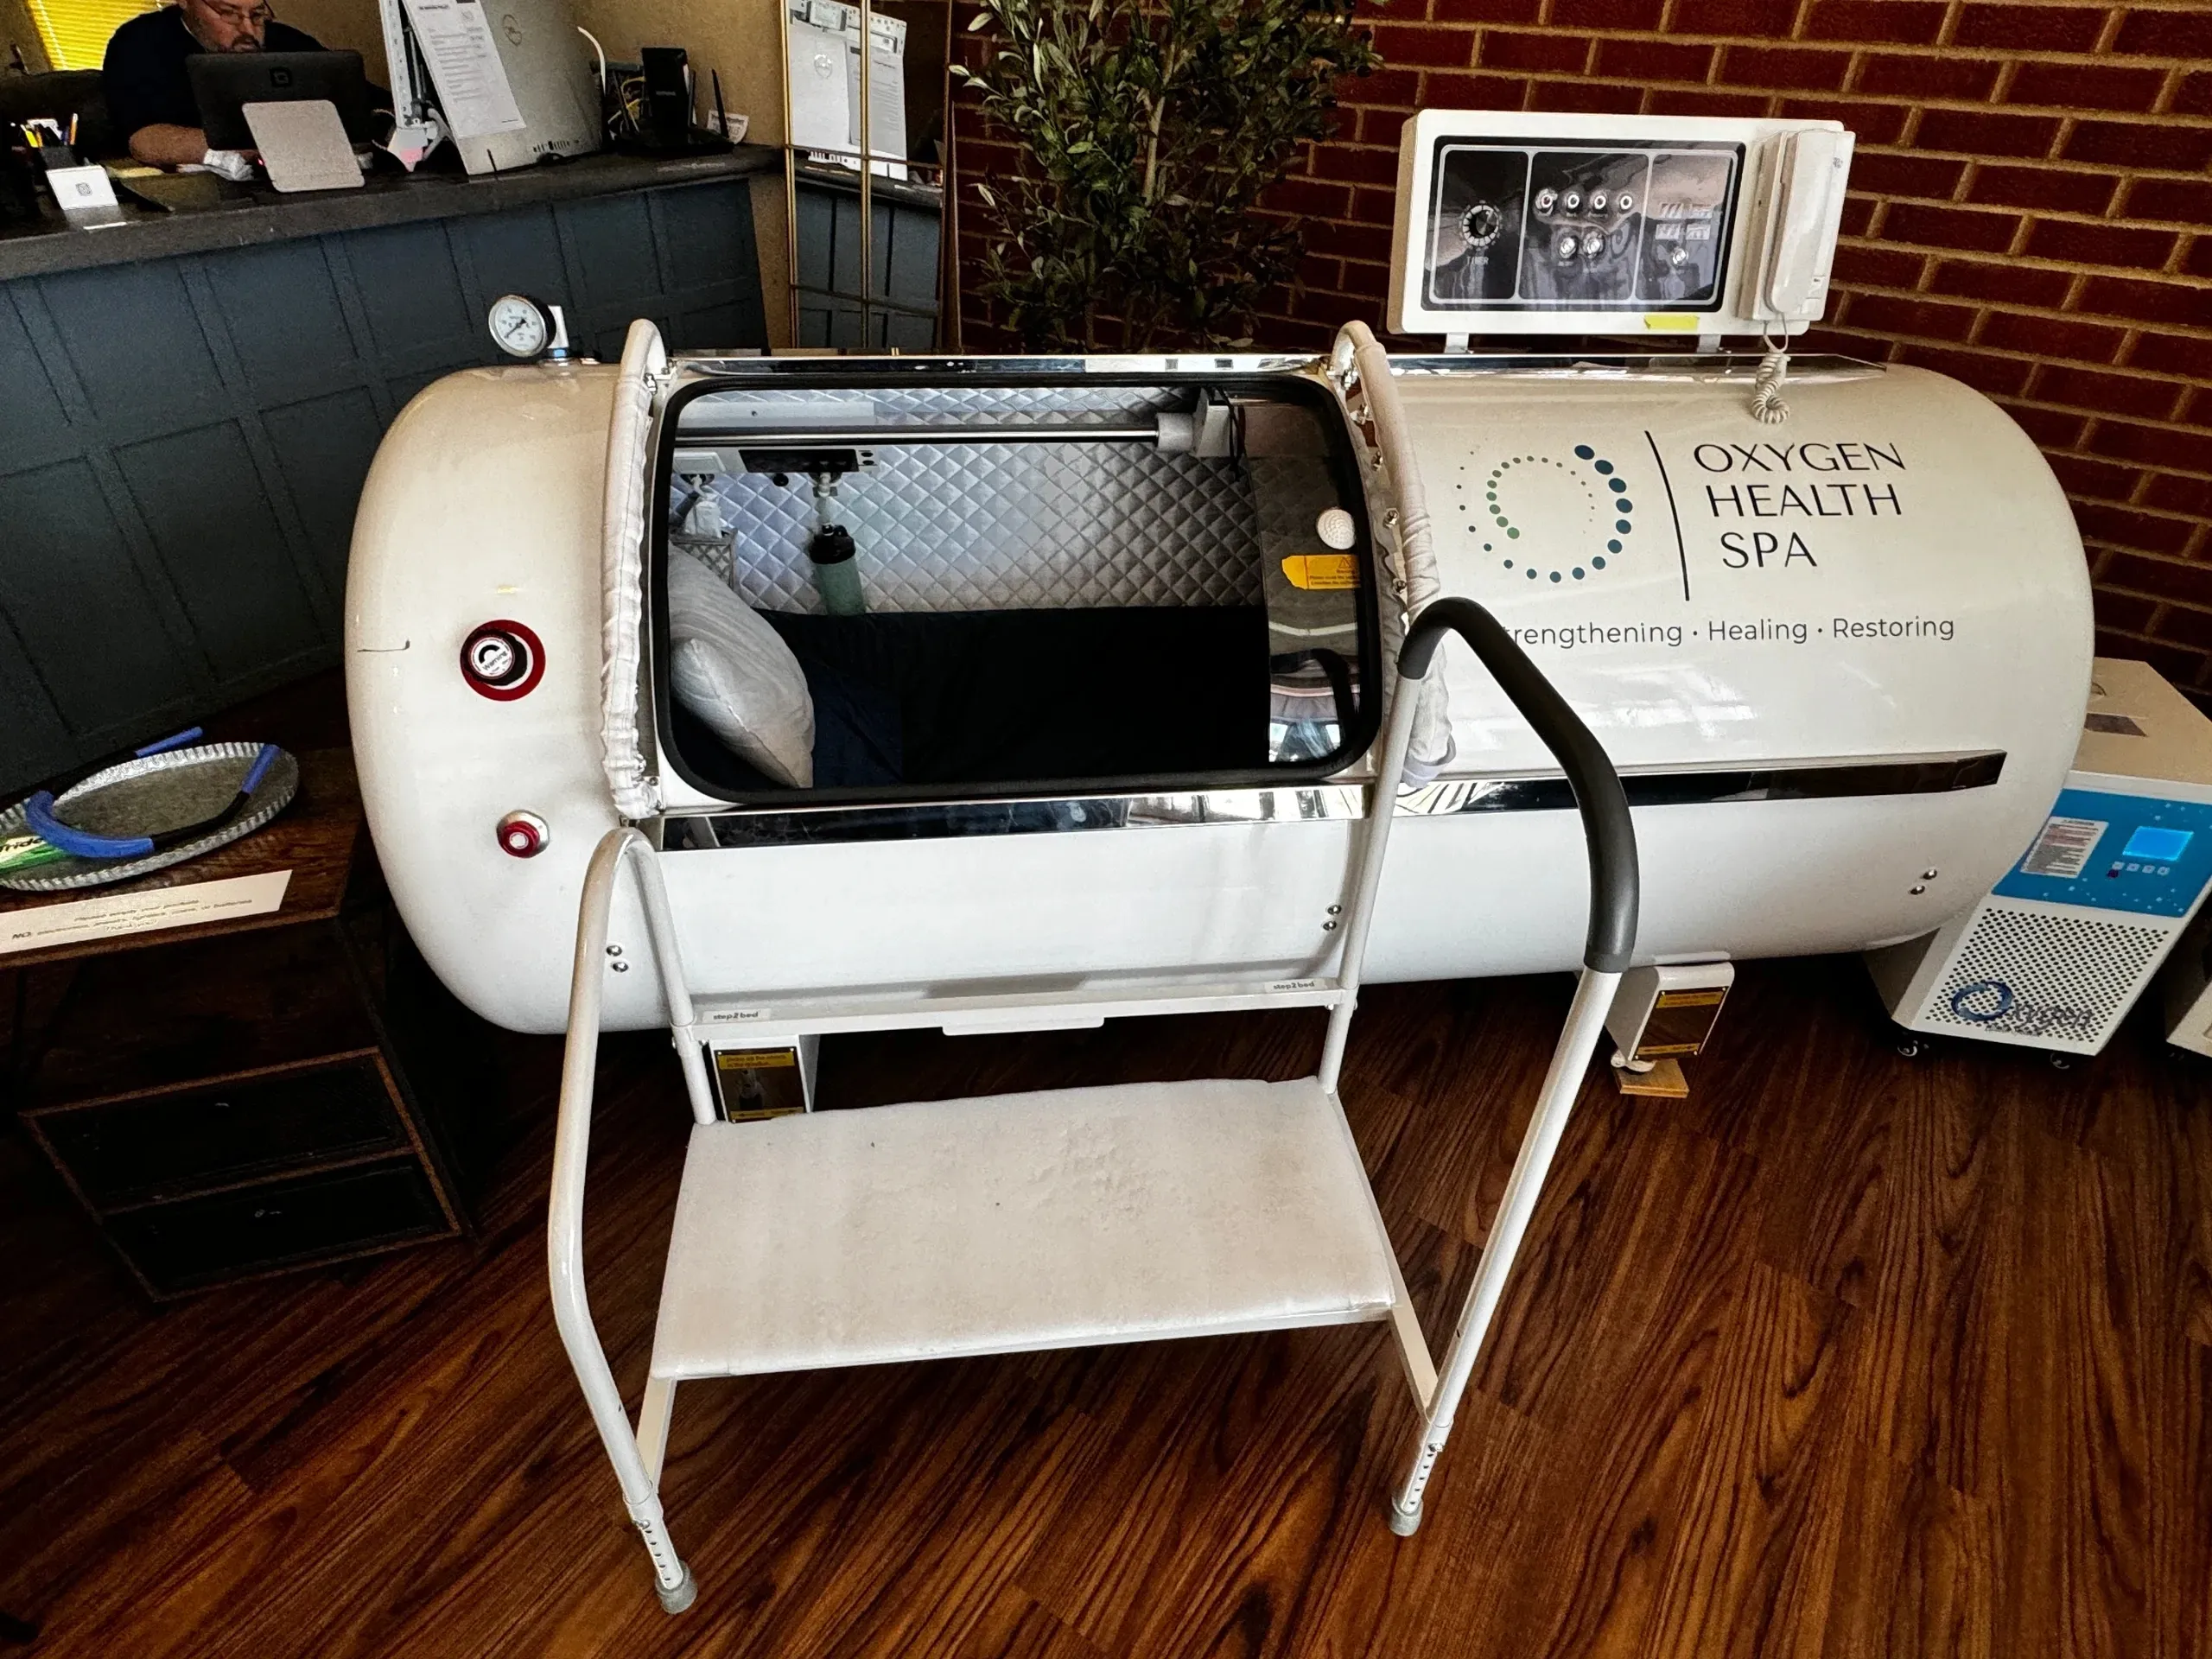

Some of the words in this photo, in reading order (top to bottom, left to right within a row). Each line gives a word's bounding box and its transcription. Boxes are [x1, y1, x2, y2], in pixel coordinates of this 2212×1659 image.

[1694, 442, 1906, 473] OXYGEN
[1706, 483, 1903, 518] HEALTH
[1720, 531, 1817, 569] SPA
[1502, 621, 1682, 650] rengthening
[1709, 619, 1807, 645] Healing
[1834, 615, 1954, 641] Restoring
[482, 651, 507, 671] Warning
